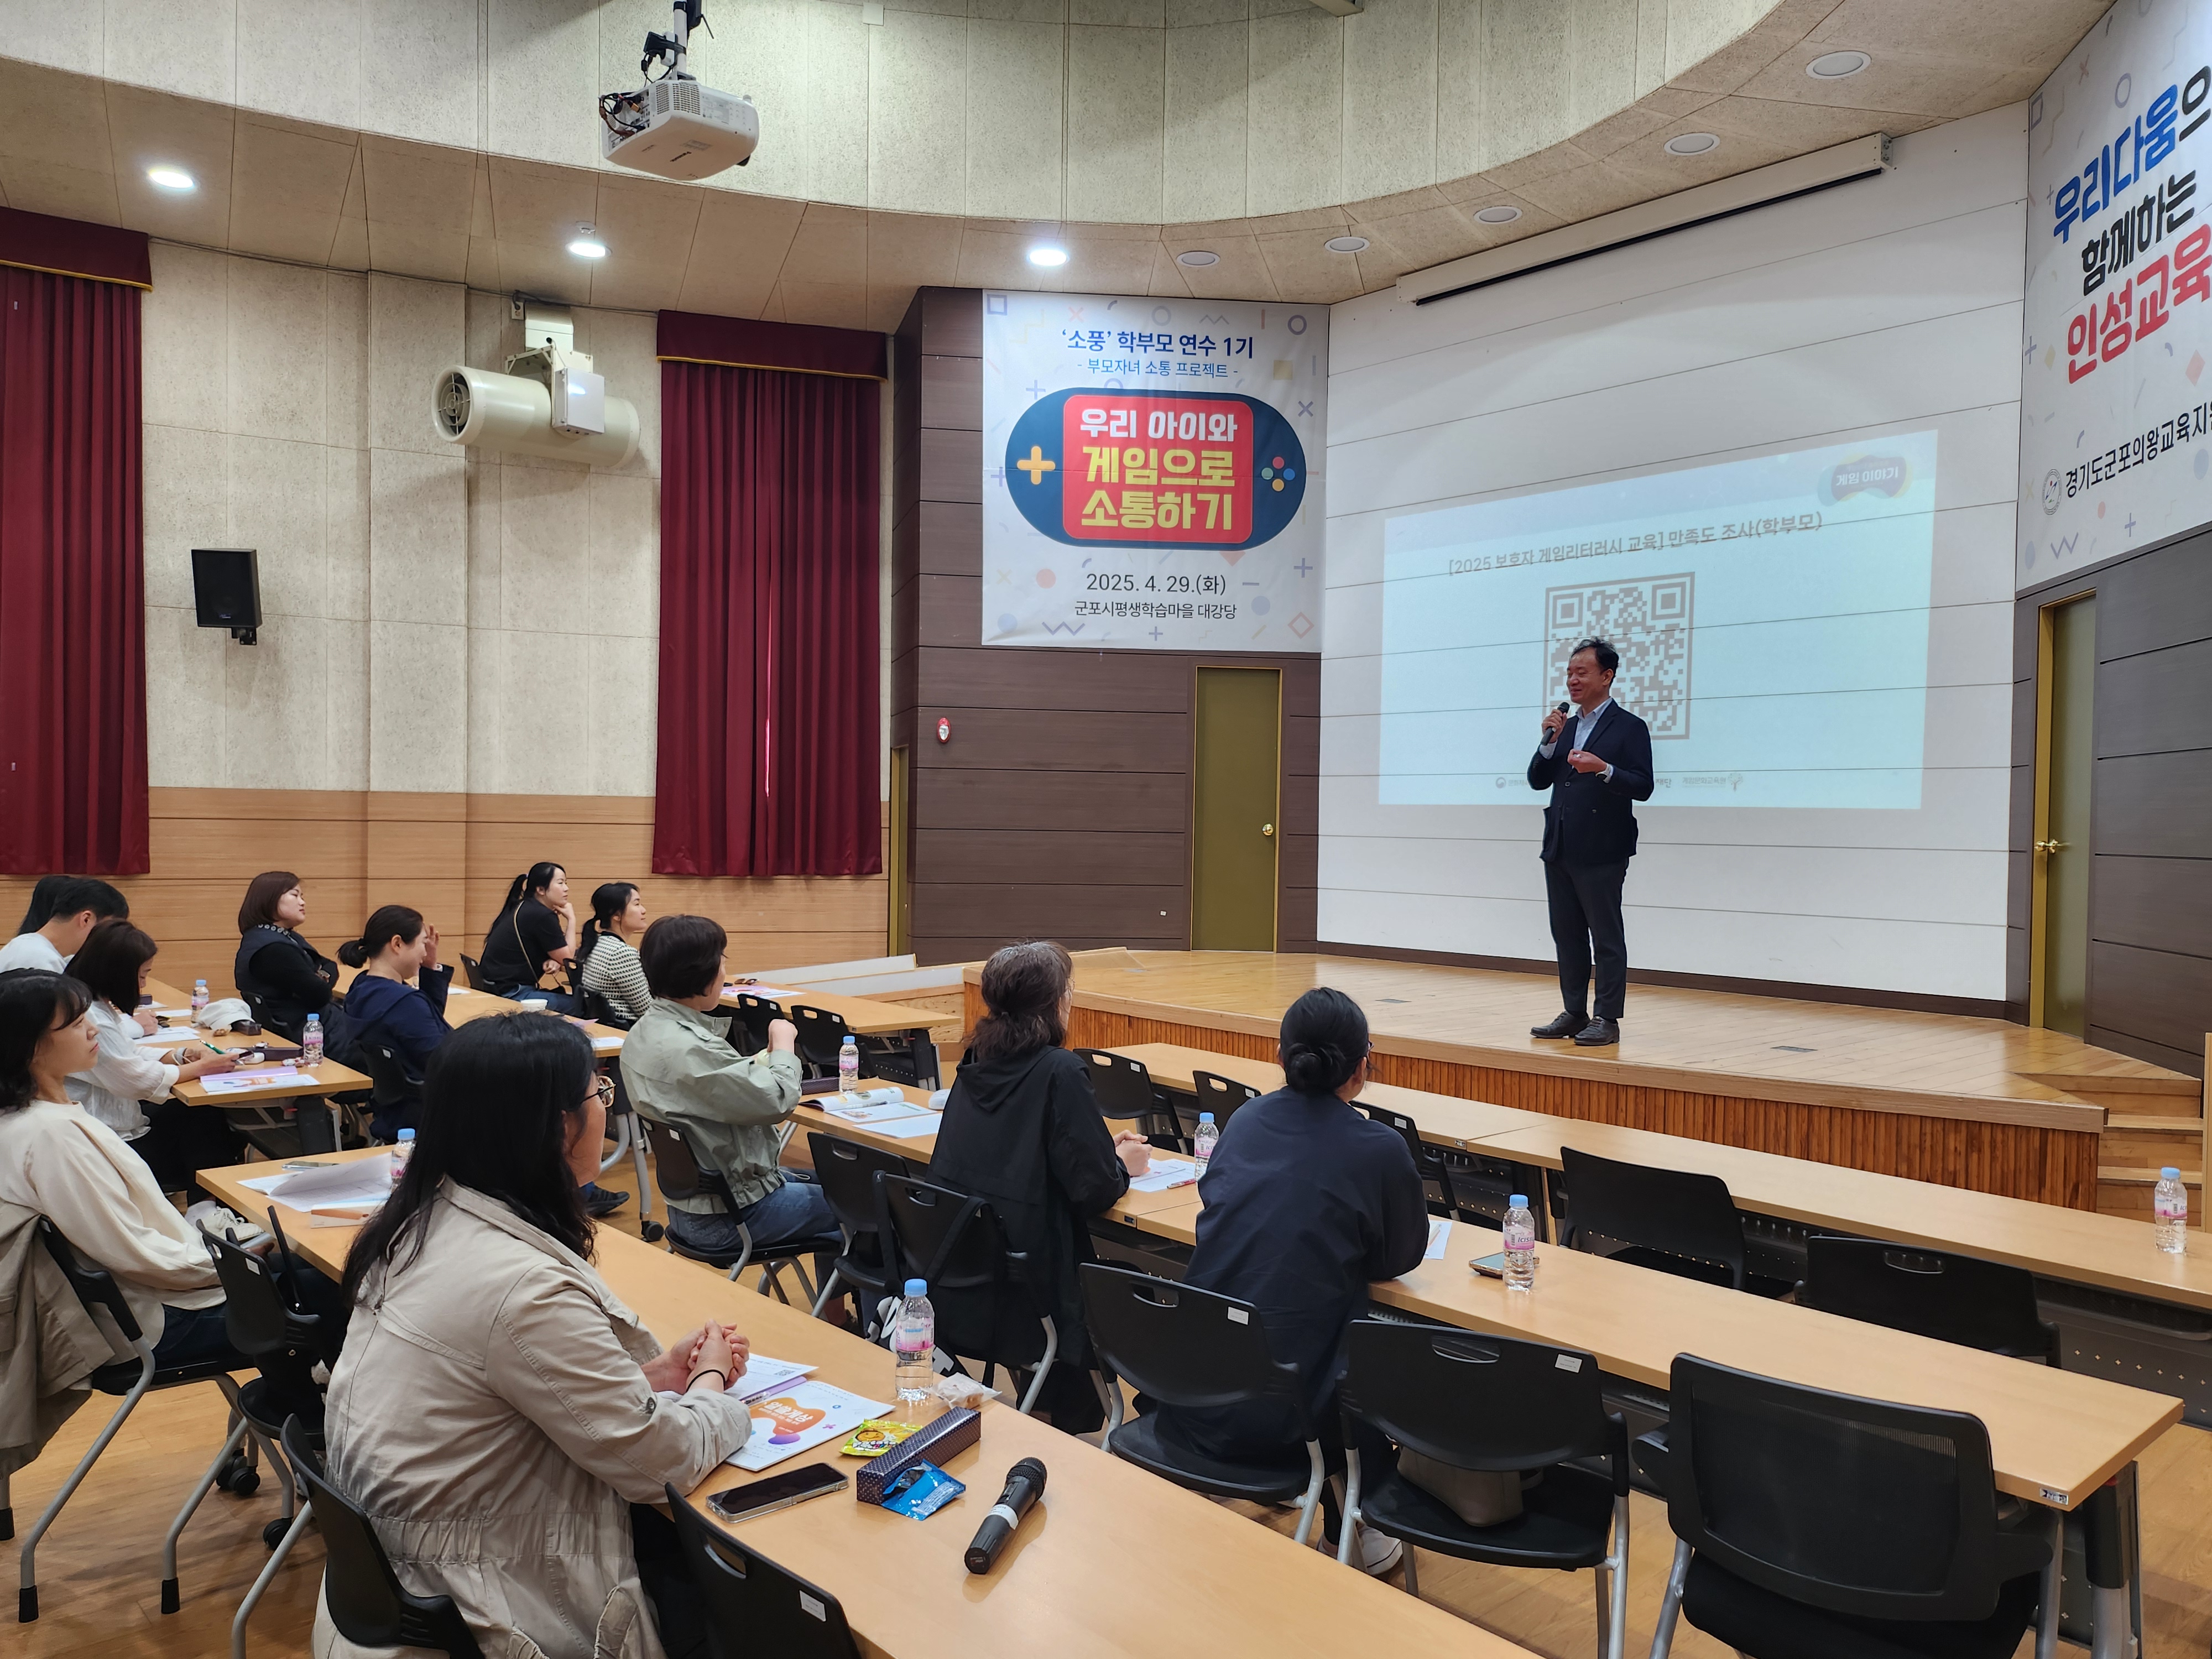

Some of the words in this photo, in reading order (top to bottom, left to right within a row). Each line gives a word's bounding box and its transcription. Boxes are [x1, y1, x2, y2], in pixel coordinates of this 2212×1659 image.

[2081, 169, 2197, 296] 함께하는
[2068, 223, 2212, 384] 인성교육
[1117, 331, 1174, 354] 학부모
[1179, 334, 1217, 357] 연수
[1223, 336, 1254, 359] 1기
[1087, 358, 1140, 375] 부모자녀
[1145, 361, 1171, 377] 소통
[1175, 363, 1228, 379] 프로젝트
[1080, 408, 1137, 439] 우리
[1148, 411, 1238, 442] 아이와
[1082, 445, 1235, 487] 게임으로
[2066, 400, 2212, 498] 경기도군포의왕교육지
[1836, 472, 1860, 486] 게임
[1862, 466, 1899, 483] 이야기
[1081, 489, 1232, 530] 소통하기
[1449, 555, 1491, 576] [2025
[1495, 549, 1534, 569] 보호자
[1538, 538, 1623, 564] 게임리터러시
[1628, 531, 1665, 551] 교육]
[1668, 526, 1718, 547] 만족도
[1721, 511, 1823, 540] 조사(학부모)
[1086, 573, 1139, 592] 2025.
[1144, 575, 1161, 592] 4.
[1166, 574, 1226, 596] 29.(화)
[1074, 601, 1194, 619] 군포시평생학습마을
[1198, 603, 1238, 620] 대강당
